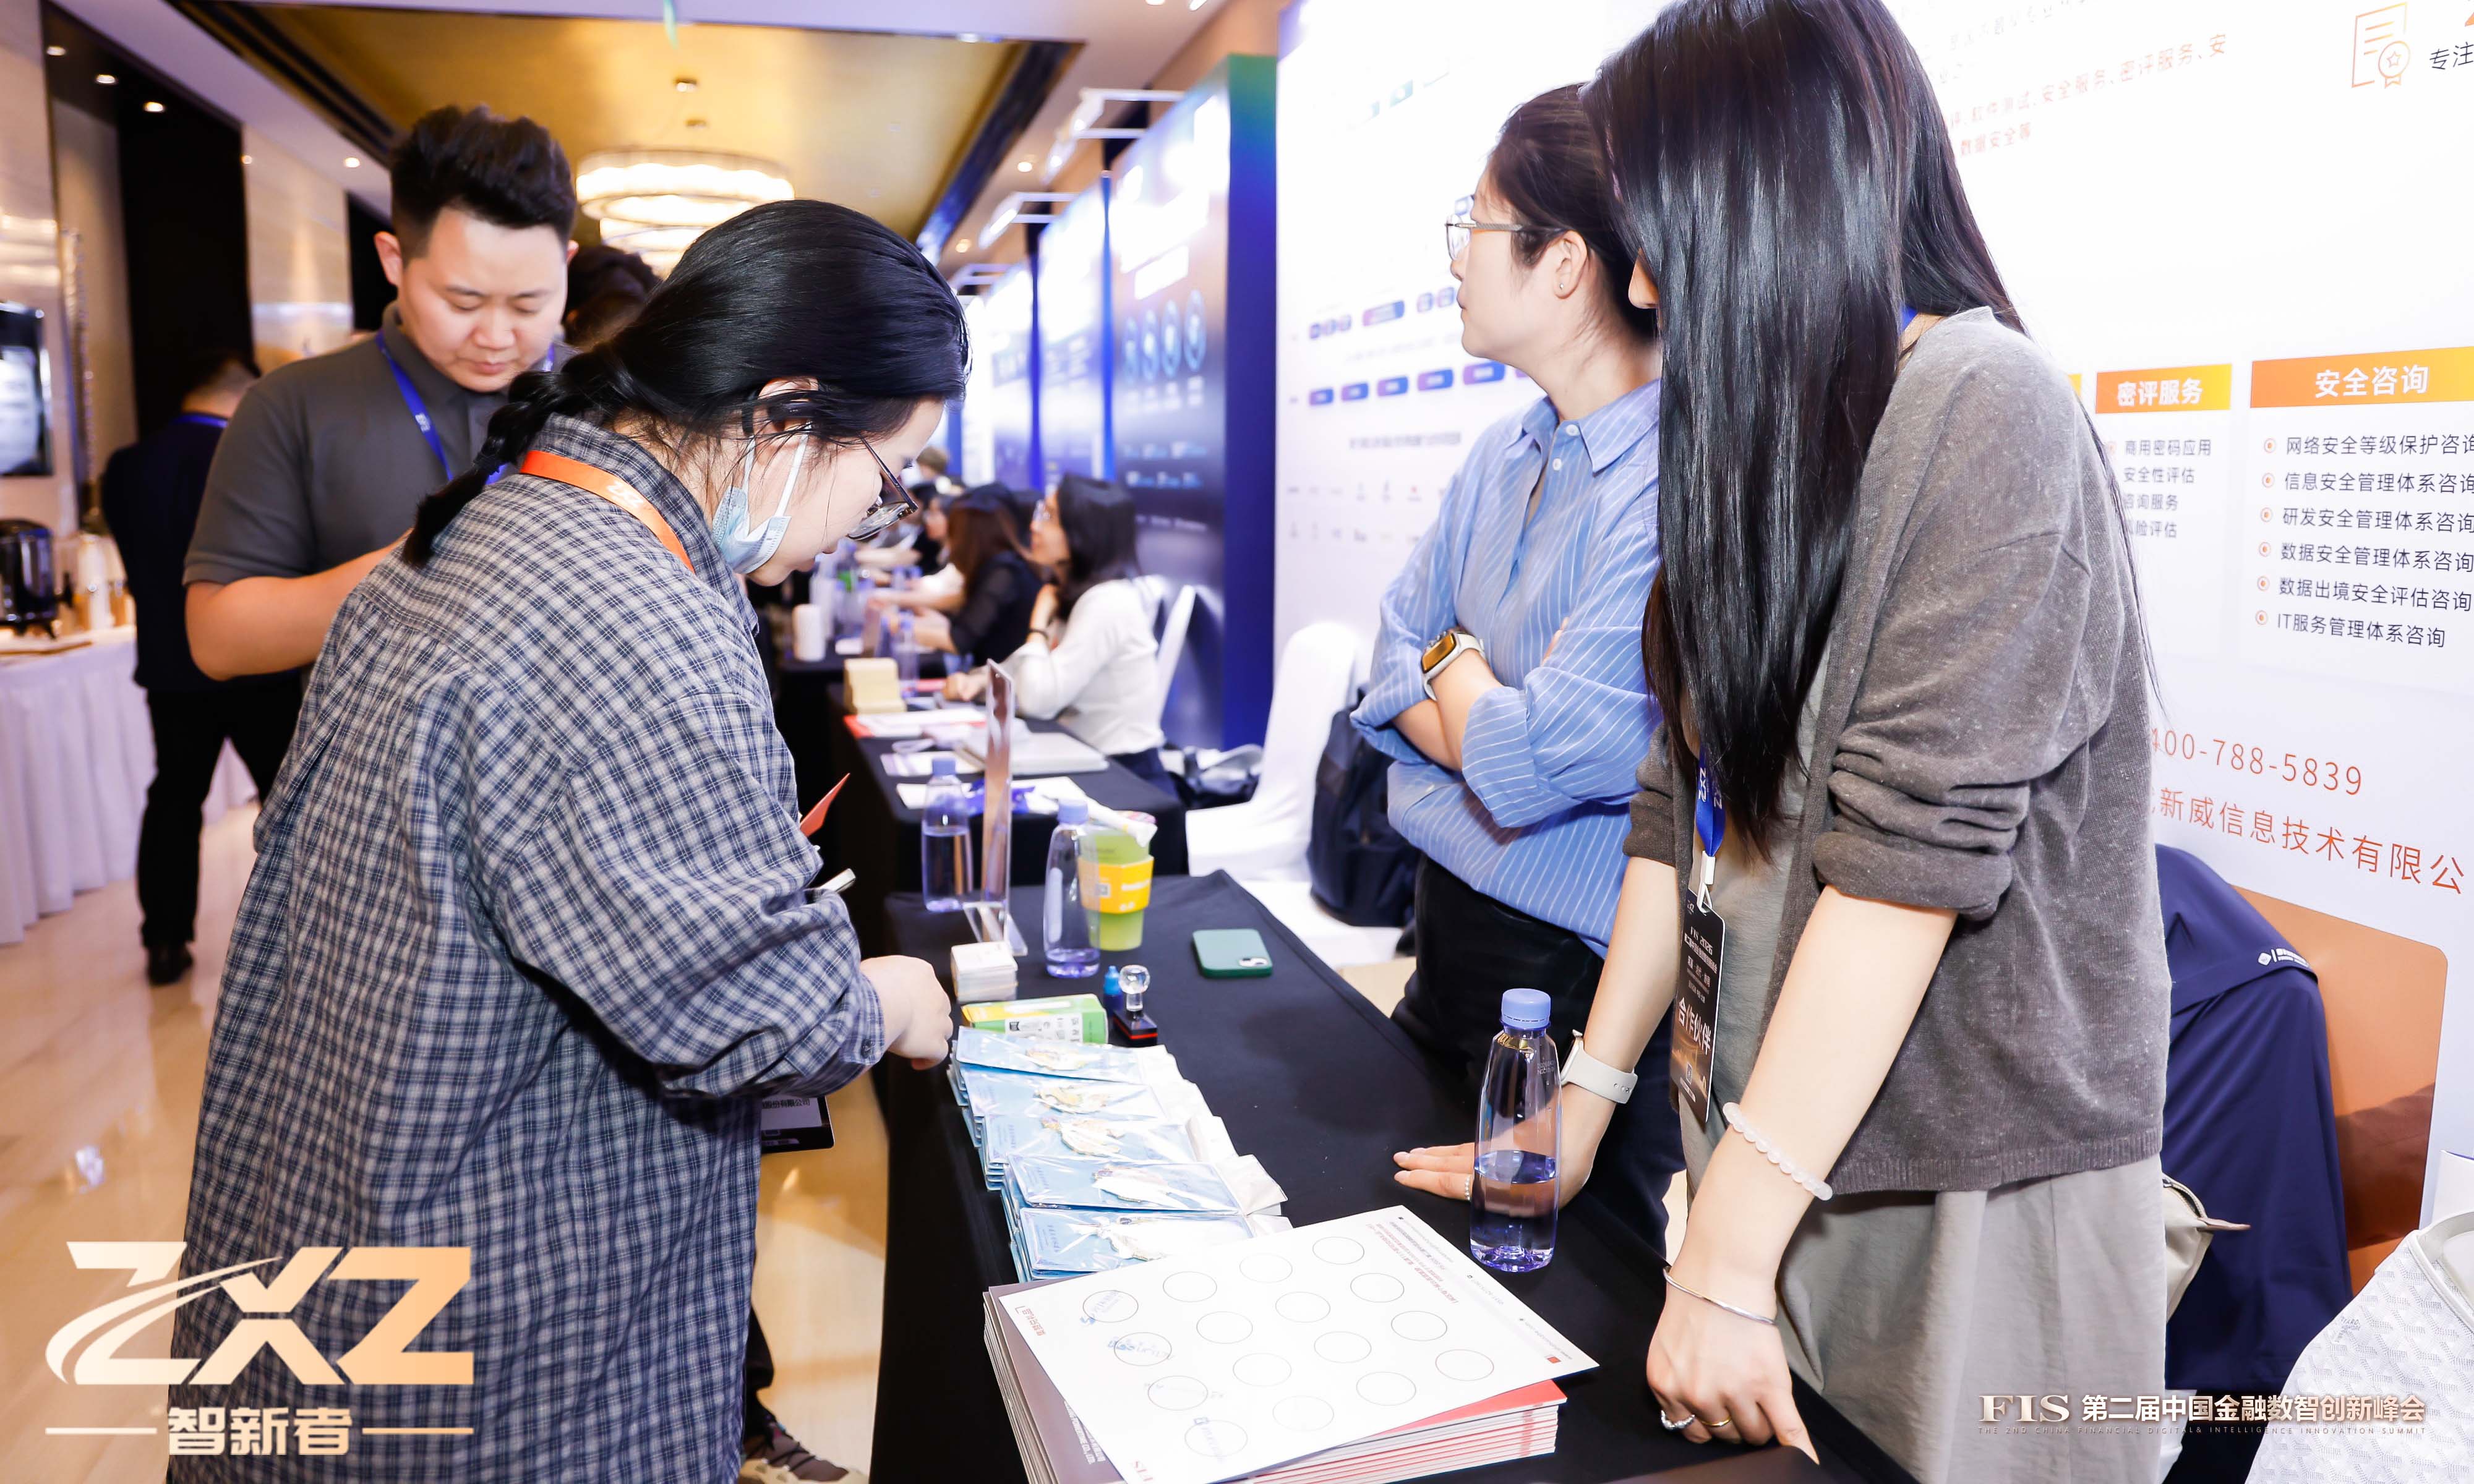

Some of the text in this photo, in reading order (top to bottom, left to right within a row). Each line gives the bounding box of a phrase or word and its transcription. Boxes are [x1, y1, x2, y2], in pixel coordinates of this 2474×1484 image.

[2429, 41, 2474, 70] 专注
[2117, 378, 2203, 406] 密评服务
[2314, 365, 2429, 398] 安全咨询
[2125, 440, 2212, 456] 商用密码应用
[2286, 433, 2474, 456] 网络安全等级保护咨询
[2124, 466, 2196, 484] 安全性评估
[2285, 471, 2474, 494] 信息安全管理体系咨询
[2283, 507, 2474, 534] 研发安全管理体系咨询
[2280, 542, 2474, 573] 数据安全管理体系咨询
[2279, 577, 2472, 612] 数据出境安全评估咨询
[2277, 613, 2446, 647] IT服务管理体系咨询
[2152, 787, 2465, 895] 新威信息技术有限公
[1678, 997, 1711, 1056] 合作伙伴
